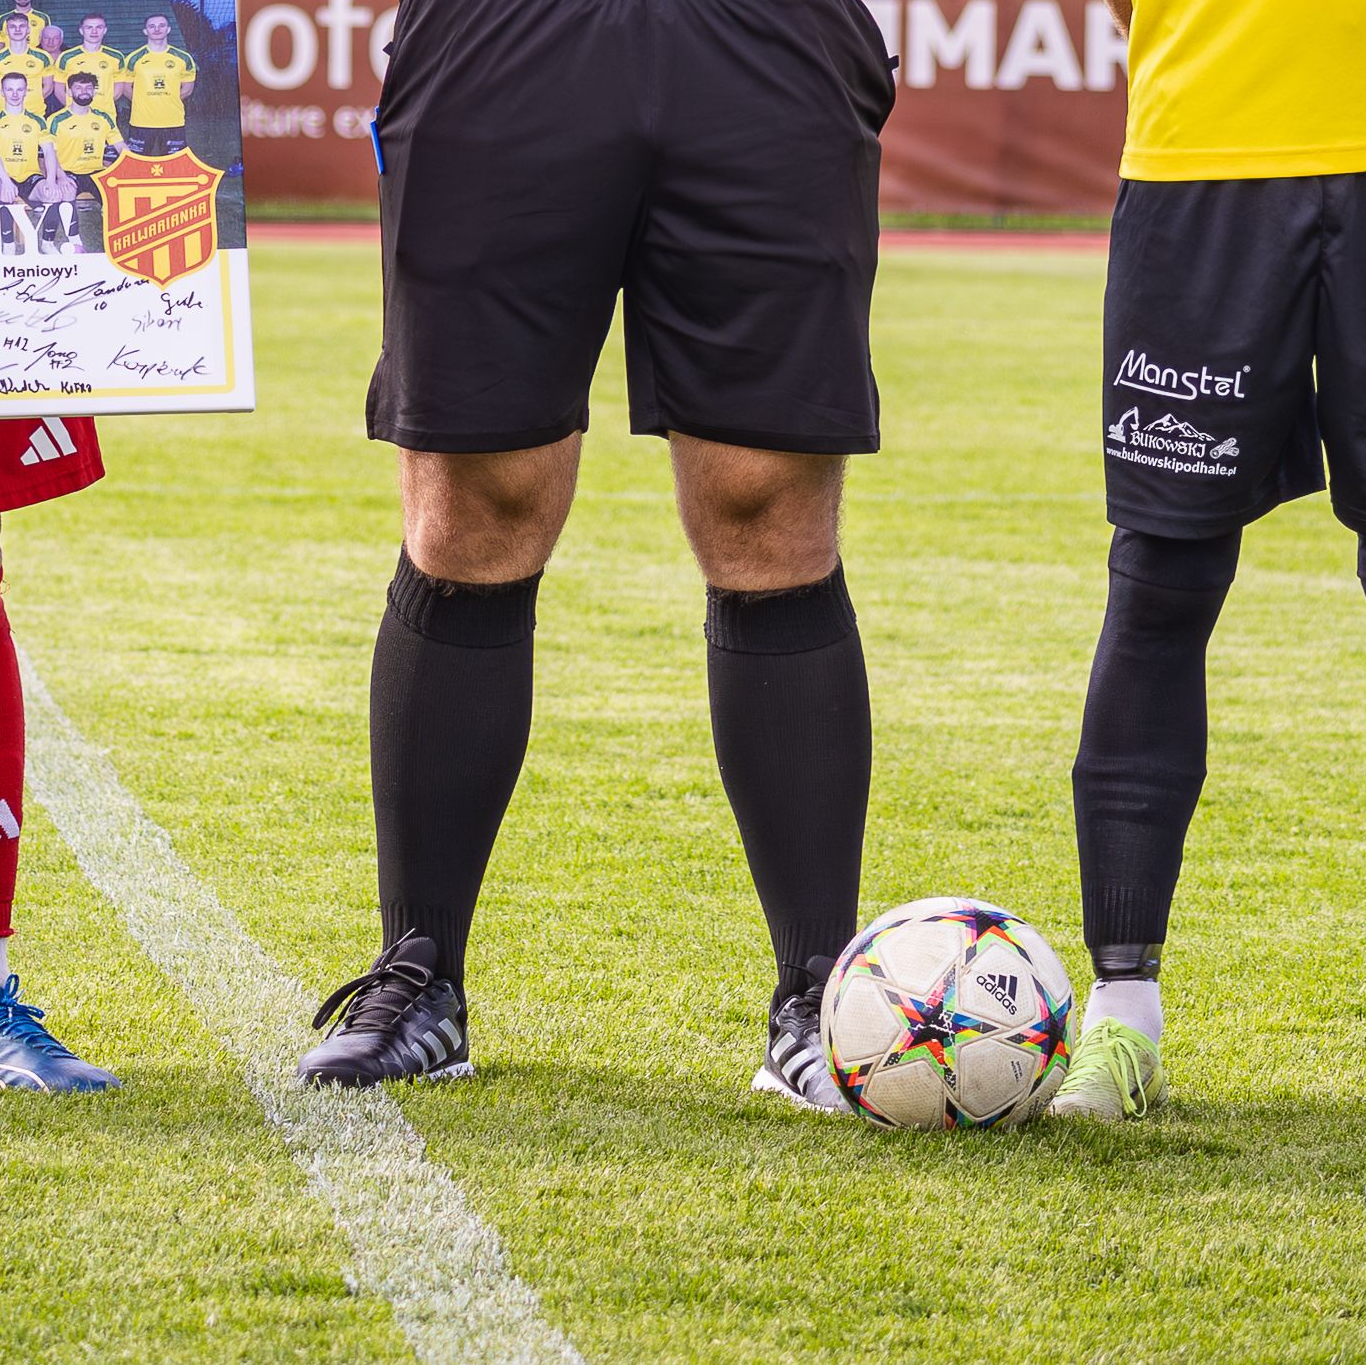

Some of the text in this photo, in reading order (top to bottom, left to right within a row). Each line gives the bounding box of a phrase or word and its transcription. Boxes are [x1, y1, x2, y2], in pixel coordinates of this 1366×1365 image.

[113, 201, 207, 253] KALWARIANKA
[3, 264, 78, 279] Maniowy!
[1106, 446, 1237, 477] www.bukowskipodhale.pl
[976, 974, 1018, 1016] adidas
